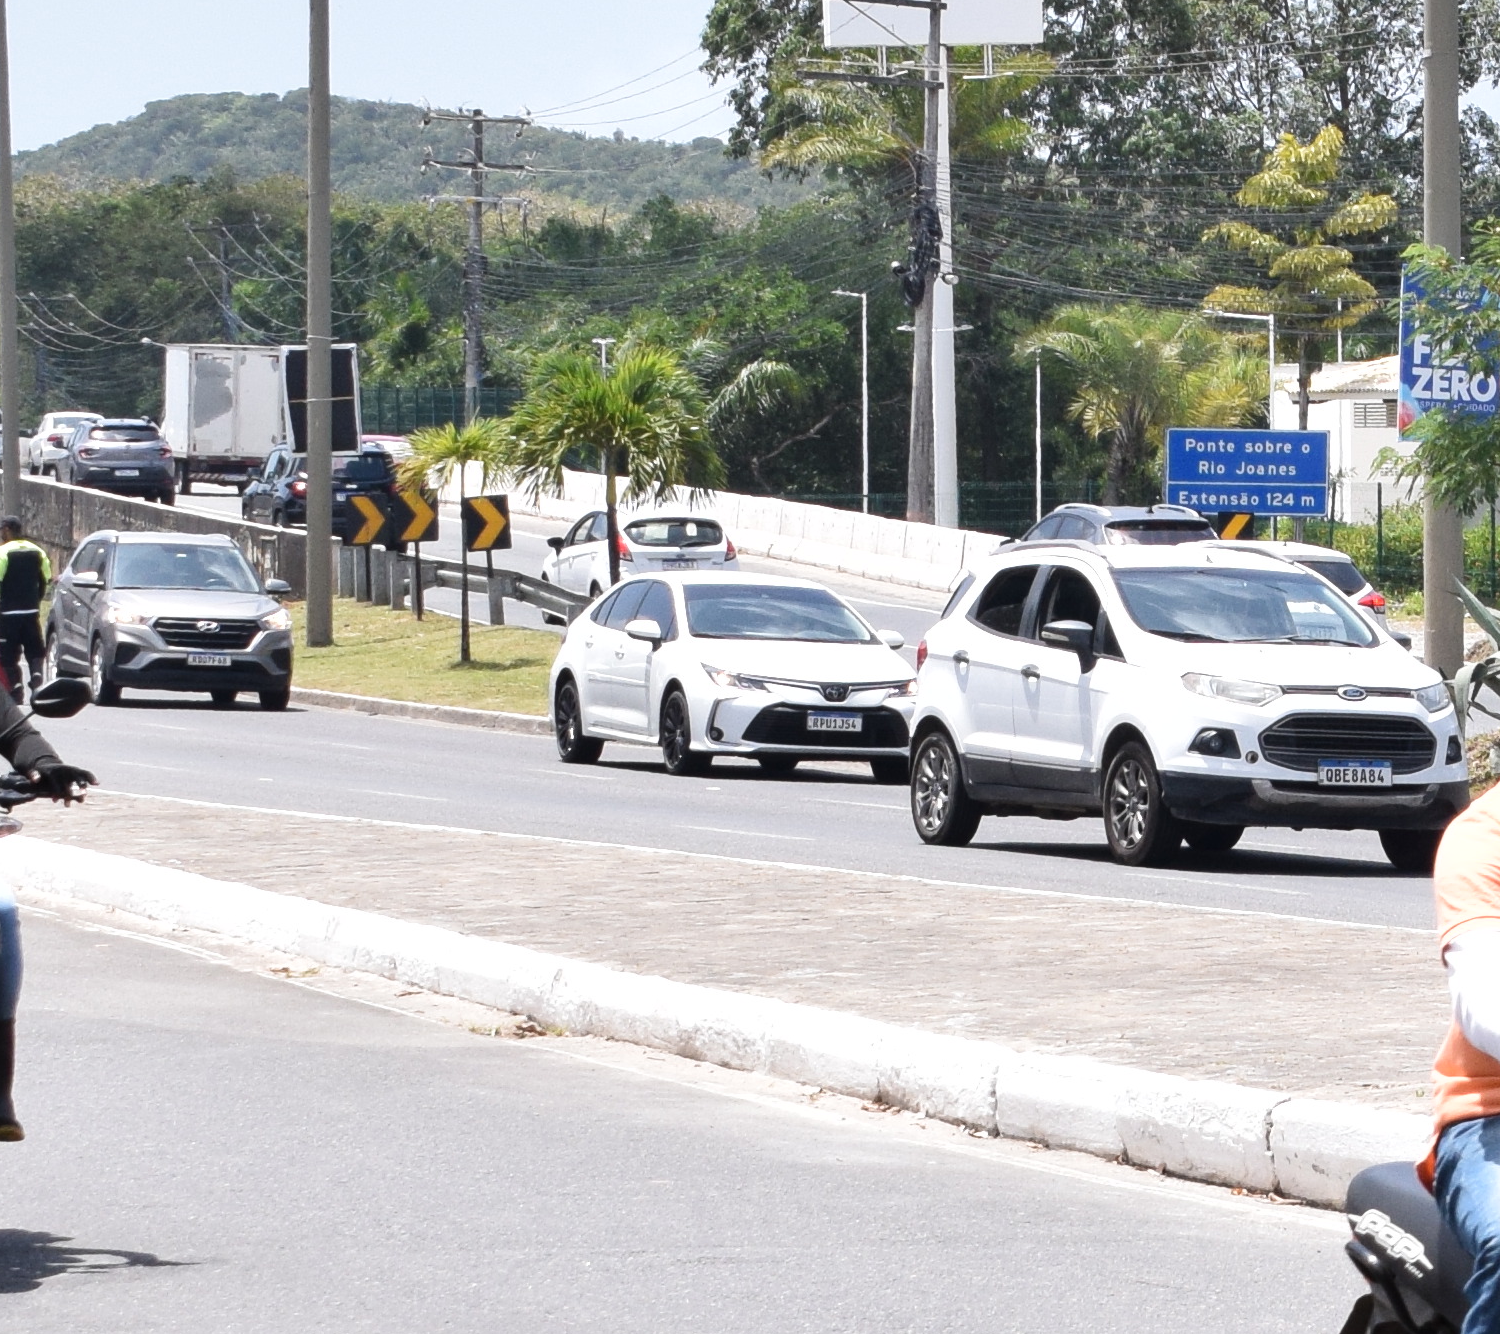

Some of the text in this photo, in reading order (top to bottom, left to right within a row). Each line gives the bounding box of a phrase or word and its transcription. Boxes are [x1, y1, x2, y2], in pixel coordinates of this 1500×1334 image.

[1411, 367, 1497, 403] ZERO
[1185, 438, 1311, 454] Ponte sobre o
[1198, 460, 1297, 476] Rio Joanes
[1178, 490, 1315, 507] Extensão 124 m
[1326, 768, 1385, 784] QBE8A84
